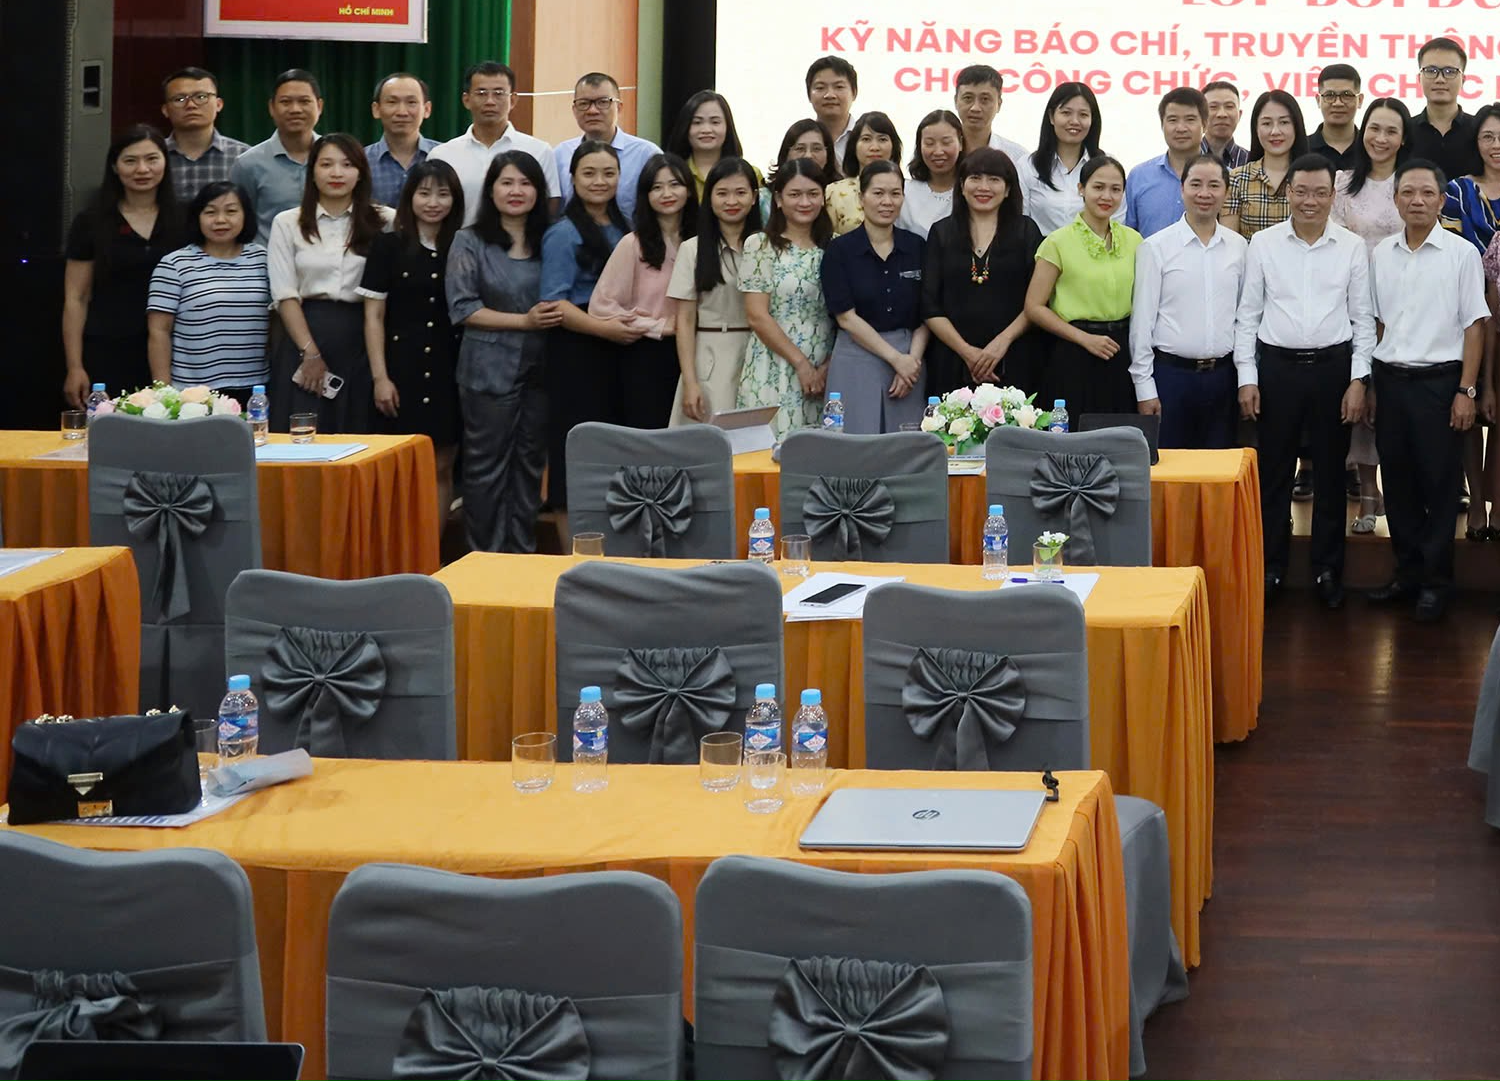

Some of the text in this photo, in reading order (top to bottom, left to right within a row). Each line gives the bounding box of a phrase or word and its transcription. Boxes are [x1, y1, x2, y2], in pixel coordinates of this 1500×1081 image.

[354, 7, 369, 15] CHÍ
[821, 19, 874, 52] KỸ
[886, 21, 1003, 54] NĂNG
[1013, 22, 1100, 56] BÁO
[1110, 23, 1191, 59] CHÍ,
[1204, 22, 1368, 59] TRUYỀN
[893, 66, 963, 93] CH
[1263, 65, 1322, 98] VIÊ
[1367, 73, 1484, 100] CHC
